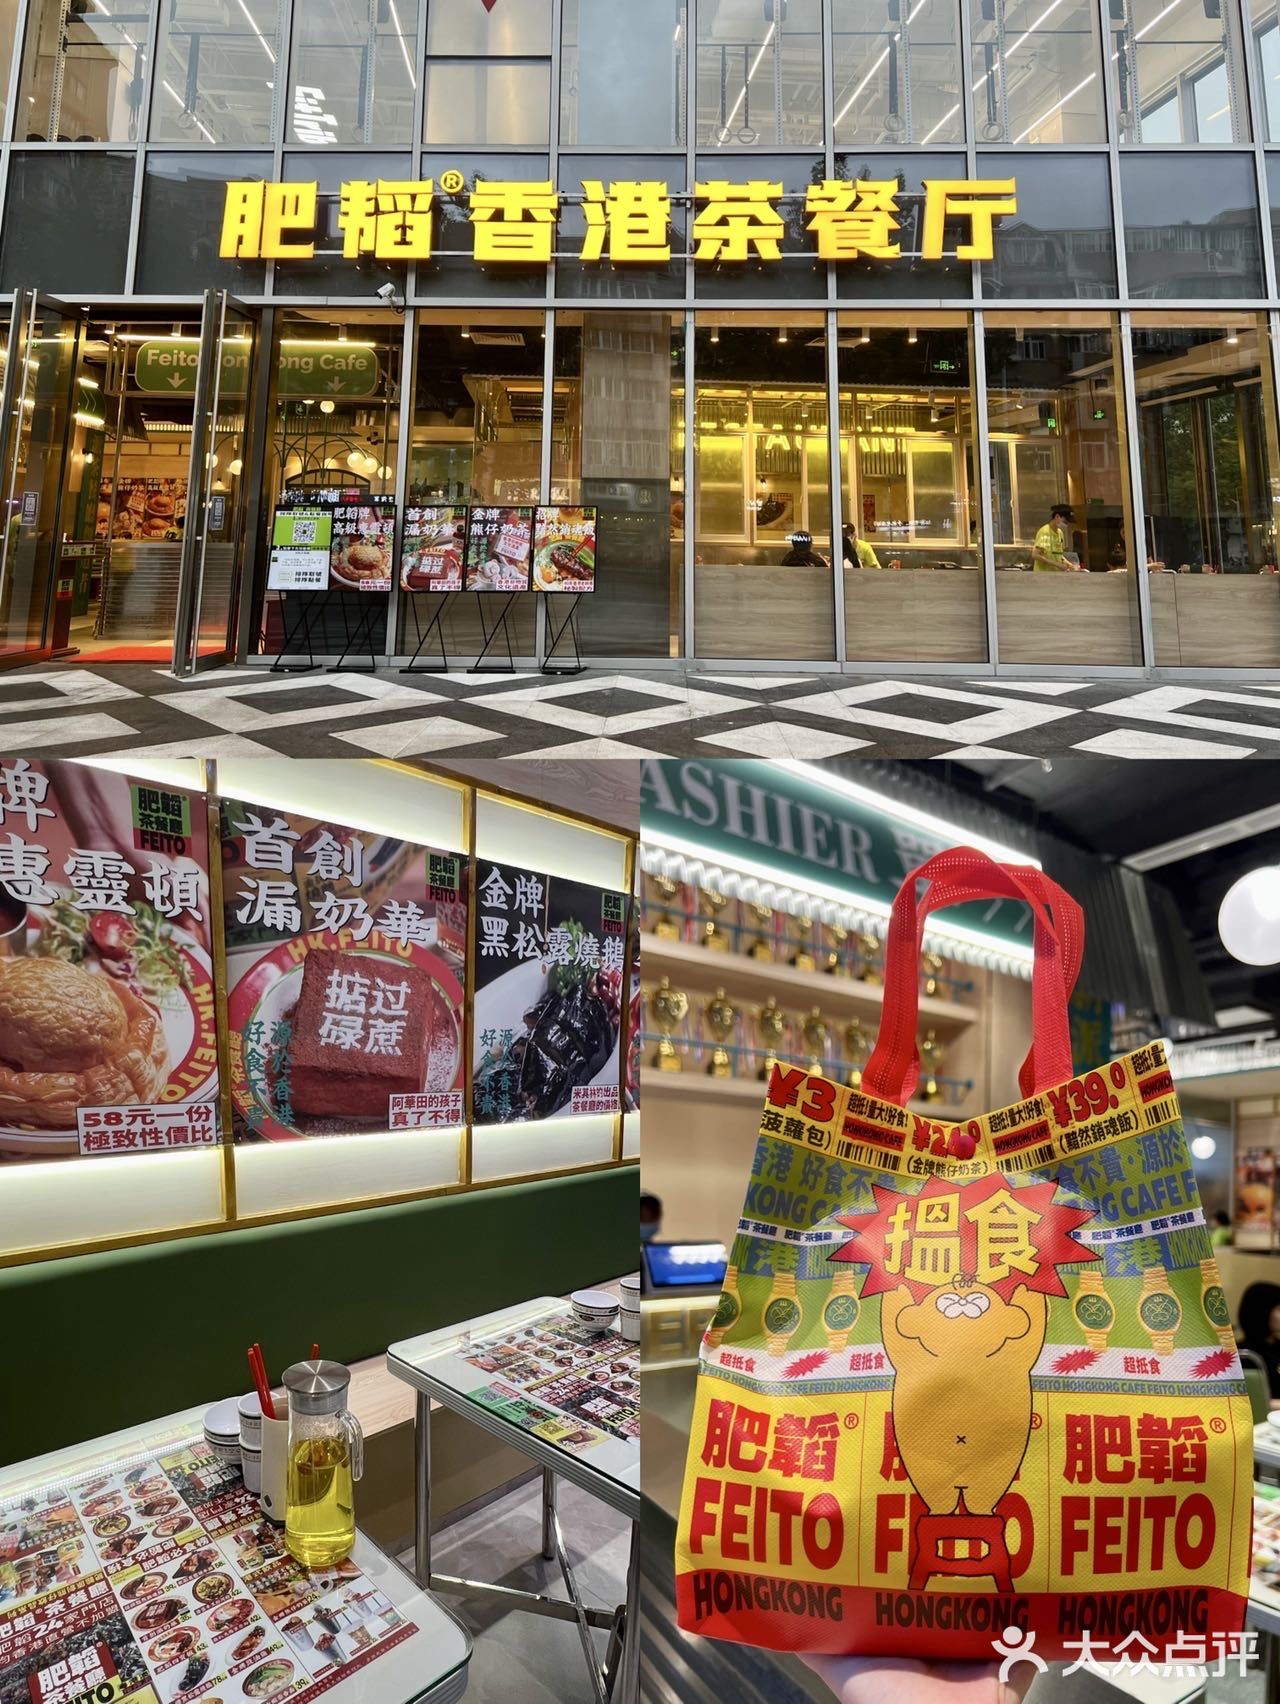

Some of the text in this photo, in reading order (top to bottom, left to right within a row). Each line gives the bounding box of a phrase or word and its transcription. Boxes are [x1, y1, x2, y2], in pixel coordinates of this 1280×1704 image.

[320, 354, 368, 370] Cafe
[405, 508, 437, 521] 首創
[472, 508, 500, 520] 金牌
[138, 812, 183, 835] 茶餐廳
[140, 830, 186, 855] FEITO
[232, 813, 365, 887] 首創
[430, 885, 456, 904] FEITO
[479, 866, 545, 919] 金牌
[236, 875, 432, 948] 漏奶華
[479, 915, 624, 972] 黑松露燒鵝
[391, 1092, 461, 1110] 阿華田的孩子
[767, 1063, 837, 1123] ¥3
[83, 1104, 213, 1129] 58元一份
[391, 1108, 461, 1127] 真了不得
[83, 1124, 215, 1152] 極致性價比
[1059, 1109, 1139, 1155] (黯然銷魂飯)
[1120, 1176, 1182, 1217] CAFE
[884, 1187, 1044, 1287] 搵食
[720, 1352, 757, 1373] 超抵食
[850, 1352, 885, 1371] 超抵食
[1124, 1356, 1161, 1375] 超抵食
[703, 1366, 730, 1380] FEITO
[809, 1382, 836, 1393] FEITO
[836, 1380, 890, 1392] HONGKONG
[1033, 1379, 1061, 1391] FEITO
[1062, 1380, 1120, 1392] HONGKONG
[1121, 1382, 1146, 1393] CAFE
[1149, 1383, 1177, 1395] FEITO
[1179, 1384, 1235, 1396] HONGKONG
[689, 1477, 844, 1570] FEITO
[1060, 1493, 1216, 1576] FEITO
[693, 1571, 843, 1622] HONGKONG
[875, 1591, 1030, 1633] HONGKONG
[1057, 1588, 1209, 1636] HONGKONG
